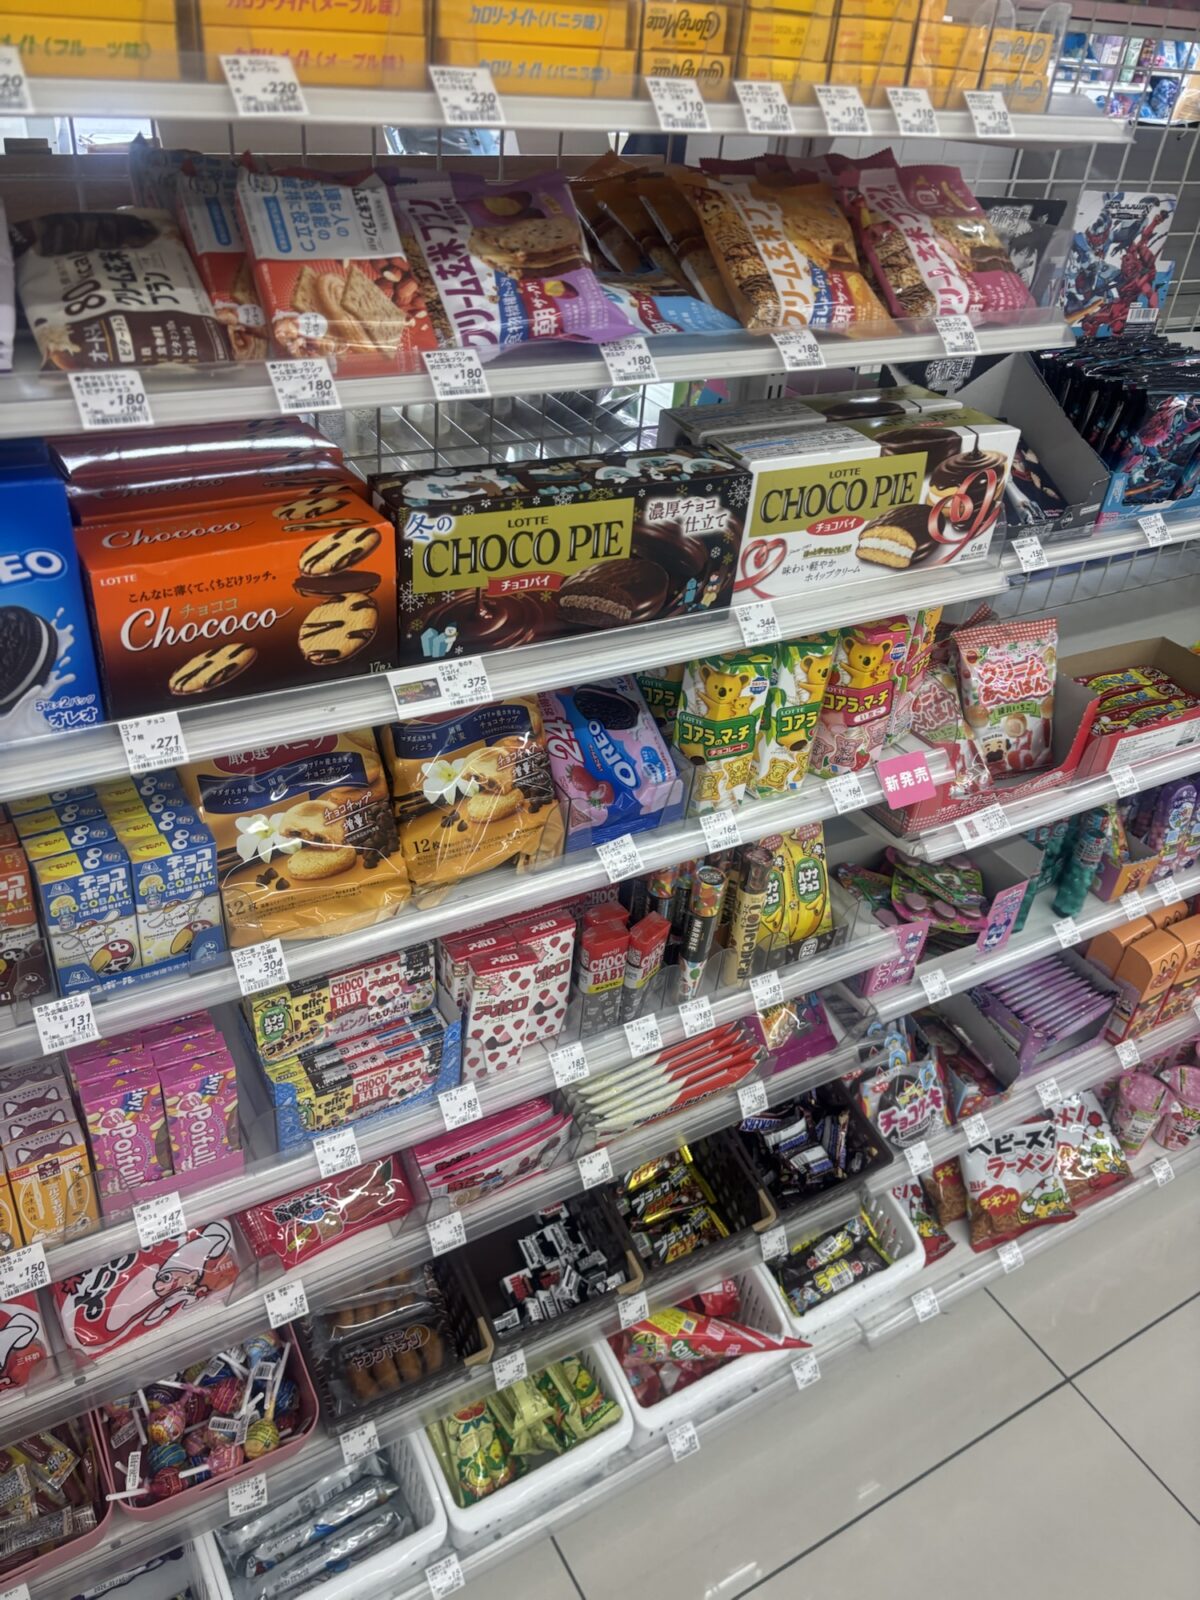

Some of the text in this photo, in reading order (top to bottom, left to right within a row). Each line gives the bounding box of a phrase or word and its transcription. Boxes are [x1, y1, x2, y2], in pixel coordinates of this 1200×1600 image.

[454, 368, 482, 379] ¥180
[301, 380, 332, 391] ¥180
[109, 393, 145, 406] ¥180
[829, 467, 861, 480] LOTTE
[760, 471, 917, 524] CHOCO PIE
[648, 498, 717, 521] 濃厚チョコ
[405, 513, 453, 543] 冬の
[508, 515, 549, 528] LOTTE
[684, 512, 729, 535] 仕立て
[815, 517, 858, 533] チョコパイ
[102, 520, 255, 549] Chococo
[422, 520, 624, 578] CHOCO PIE
[100, 574, 138, 587] LOTTE
[501, 574, 552, 592] チョコパイ
[179, 597, 239, 619] チョココ
[120, 606, 294, 652] Chococo
[463, 675, 487, 689] ¥375
[824, 688, 889, 714] コアラのマーチ
[50, 707, 98, 728] オレオ
[151, 735, 179, 750] ¥271
[682, 722, 750, 747] コアラのマーチ
[588, 720, 638, 789] OREO
[884, 766, 930, 793] 新発売
[166, 848, 213, 868] チョコ
[78, 867, 127, 888] チョコ
[168, 861, 213, 880] ボール
[80, 880, 128, 900] ボール
[688, 919, 702, 951] MARBLE
[259, 957, 283, 973] ¥304
[331, 976, 364, 996] CHOCO
[336, 991, 362, 1008] BABY
[64, 1012, 91, 1029] ¥131
[355, 1074, 387, 1092] CHOCO
[359, 1086, 385, 1103] BABY
[189, 1103, 216, 1168] Poifull
[111, 1120, 145, 1188] Poifull
[987, 1153, 1055, 1179] ラーメン
[631, 1181, 670, 1215] ブラック
[654, 1223, 692, 1260] ブラック
[19, 1261, 45, 1278] ¥150
